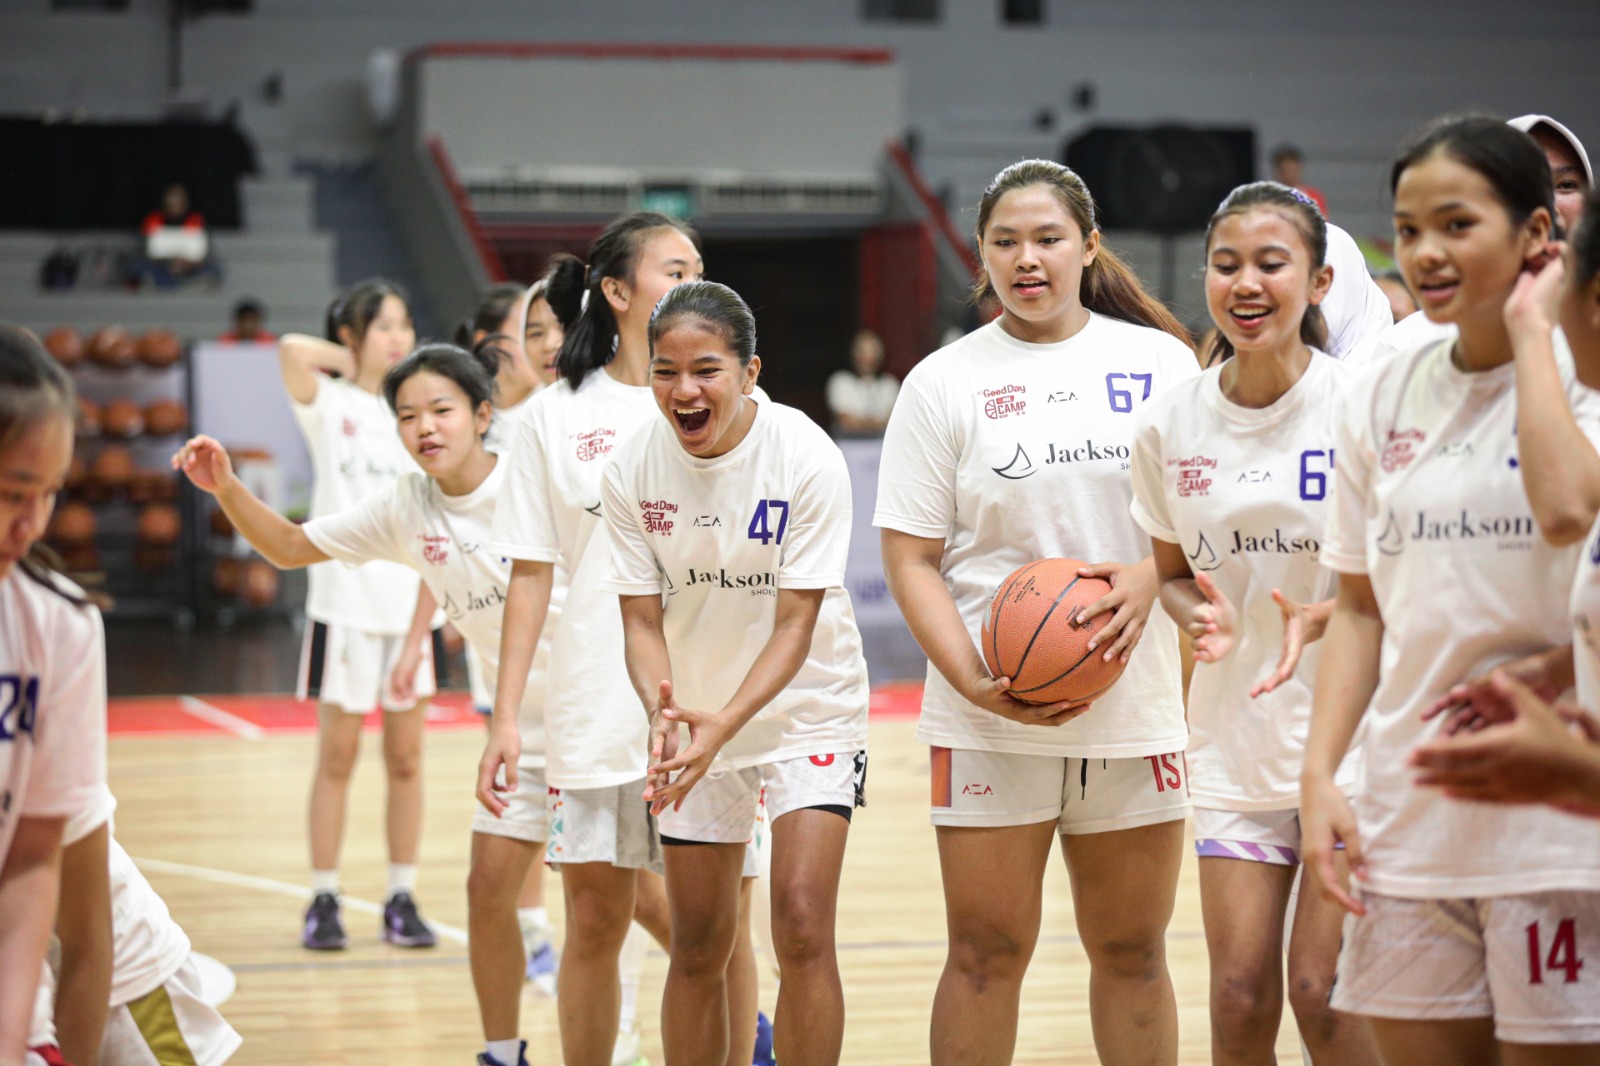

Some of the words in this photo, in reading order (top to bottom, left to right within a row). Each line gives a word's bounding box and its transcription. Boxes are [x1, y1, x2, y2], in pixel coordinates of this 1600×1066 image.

[1105, 373, 1153, 414] 67
[997, 401, 1026, 415] CAMP
[1045, 440, 1130, 465] Jackso
[660, 500, 678, 514] Day
[652, 520, 674, 531] AMP
[748, 499, 789, 545] 47
[1412, 510, 1532, 540] Jackson
[1230, 528, 1320, 554] Jackso
[686, 567, 775, 588] Jackson
[467, 586, 507, 611] Jack
[1525, 917, 1584, 985] 14
